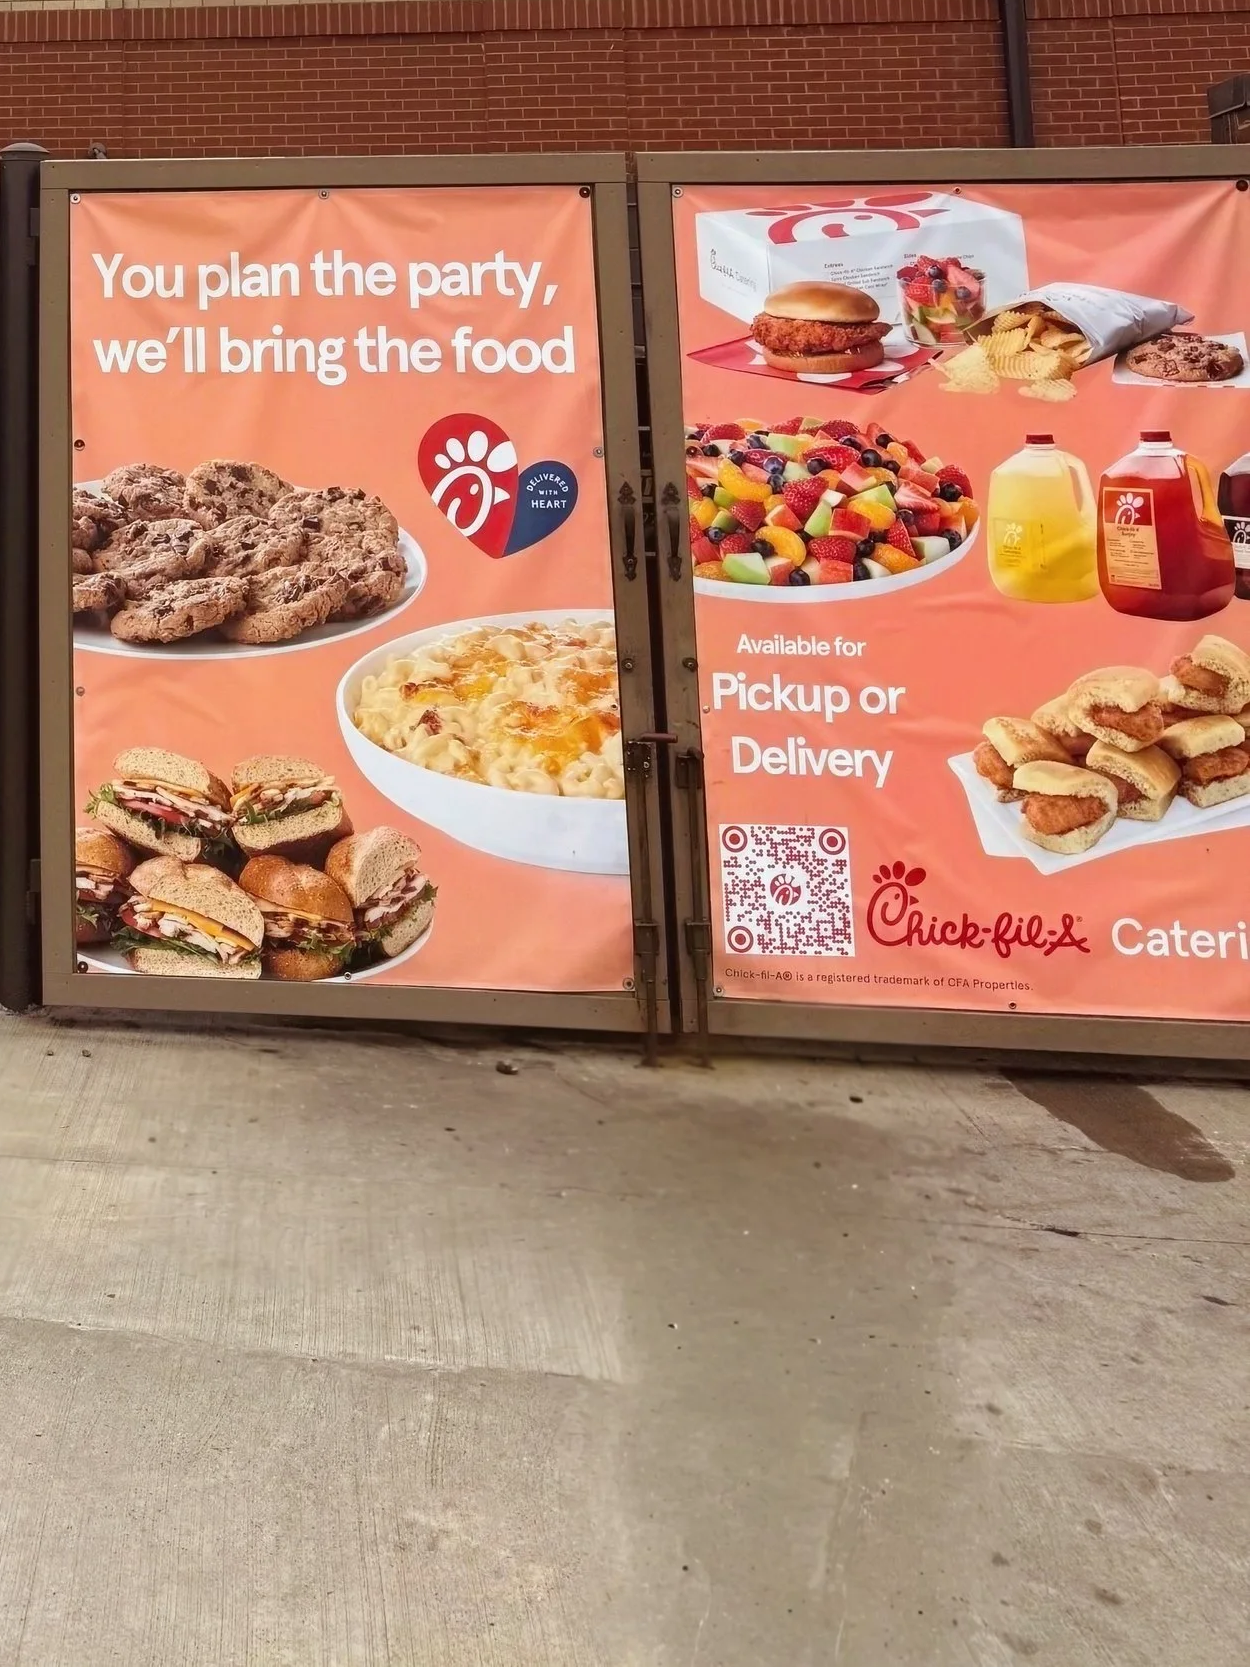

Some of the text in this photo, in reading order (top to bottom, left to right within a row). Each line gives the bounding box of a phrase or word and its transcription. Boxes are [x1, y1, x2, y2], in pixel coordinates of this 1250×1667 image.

[92, 249, 558, 310] You plan the party,
[92, 324, 575, 386] we'll bring the food
[526, 473, 569, 492] DELIVERED
[531, 499, 567, 509] HEART
[736, 633, 867, 657] Available for
[712, 671, 906, 723] Pickup or
[731, 735, 894, 789] Delivery
[1111, 917, 1249, 960] Cateri
[795, 972, 805, 982] is
[807, 975, 814, 983] a
[816, 973, 871, 985] registered
[873, 974, 930, 987] trademark
[933, 977, 944, 987] of
[947, 977, 970, 988] CFA
[972, 979, 1034, 992] Properties.
